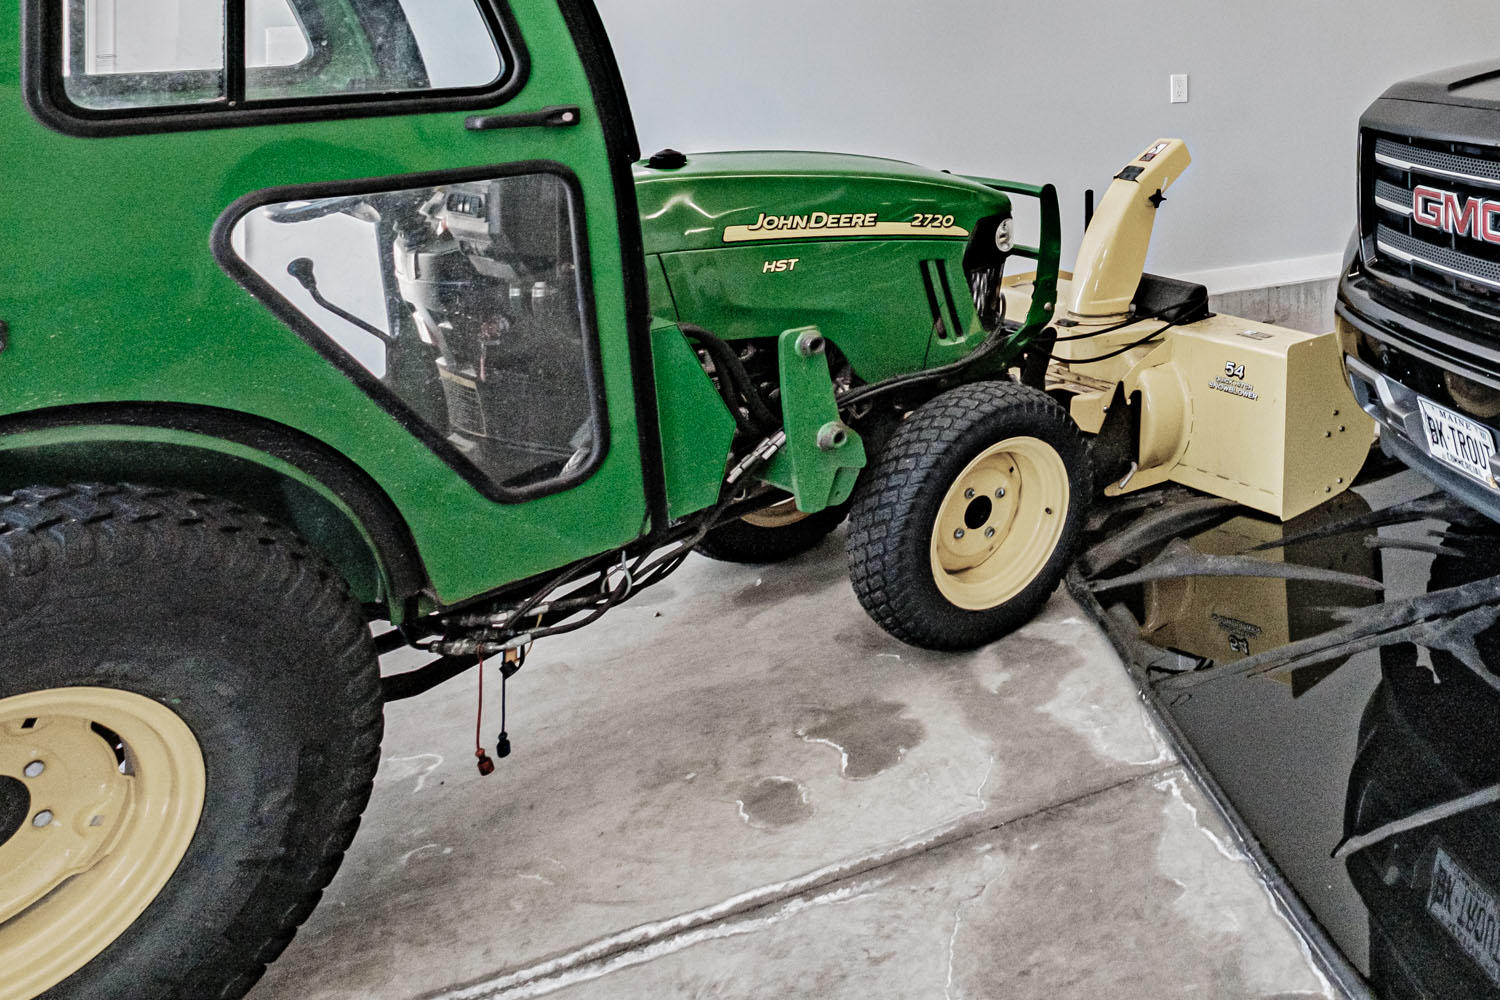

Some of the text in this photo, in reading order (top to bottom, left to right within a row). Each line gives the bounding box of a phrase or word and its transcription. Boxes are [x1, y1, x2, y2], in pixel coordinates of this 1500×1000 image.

[748, 212, 955, 231] JOHN DEERE 2720
[762, 258, 800, 273] HST
[1224, 361, 1246, 380] 54
[1439, 410, 1472, 431] MAINE
